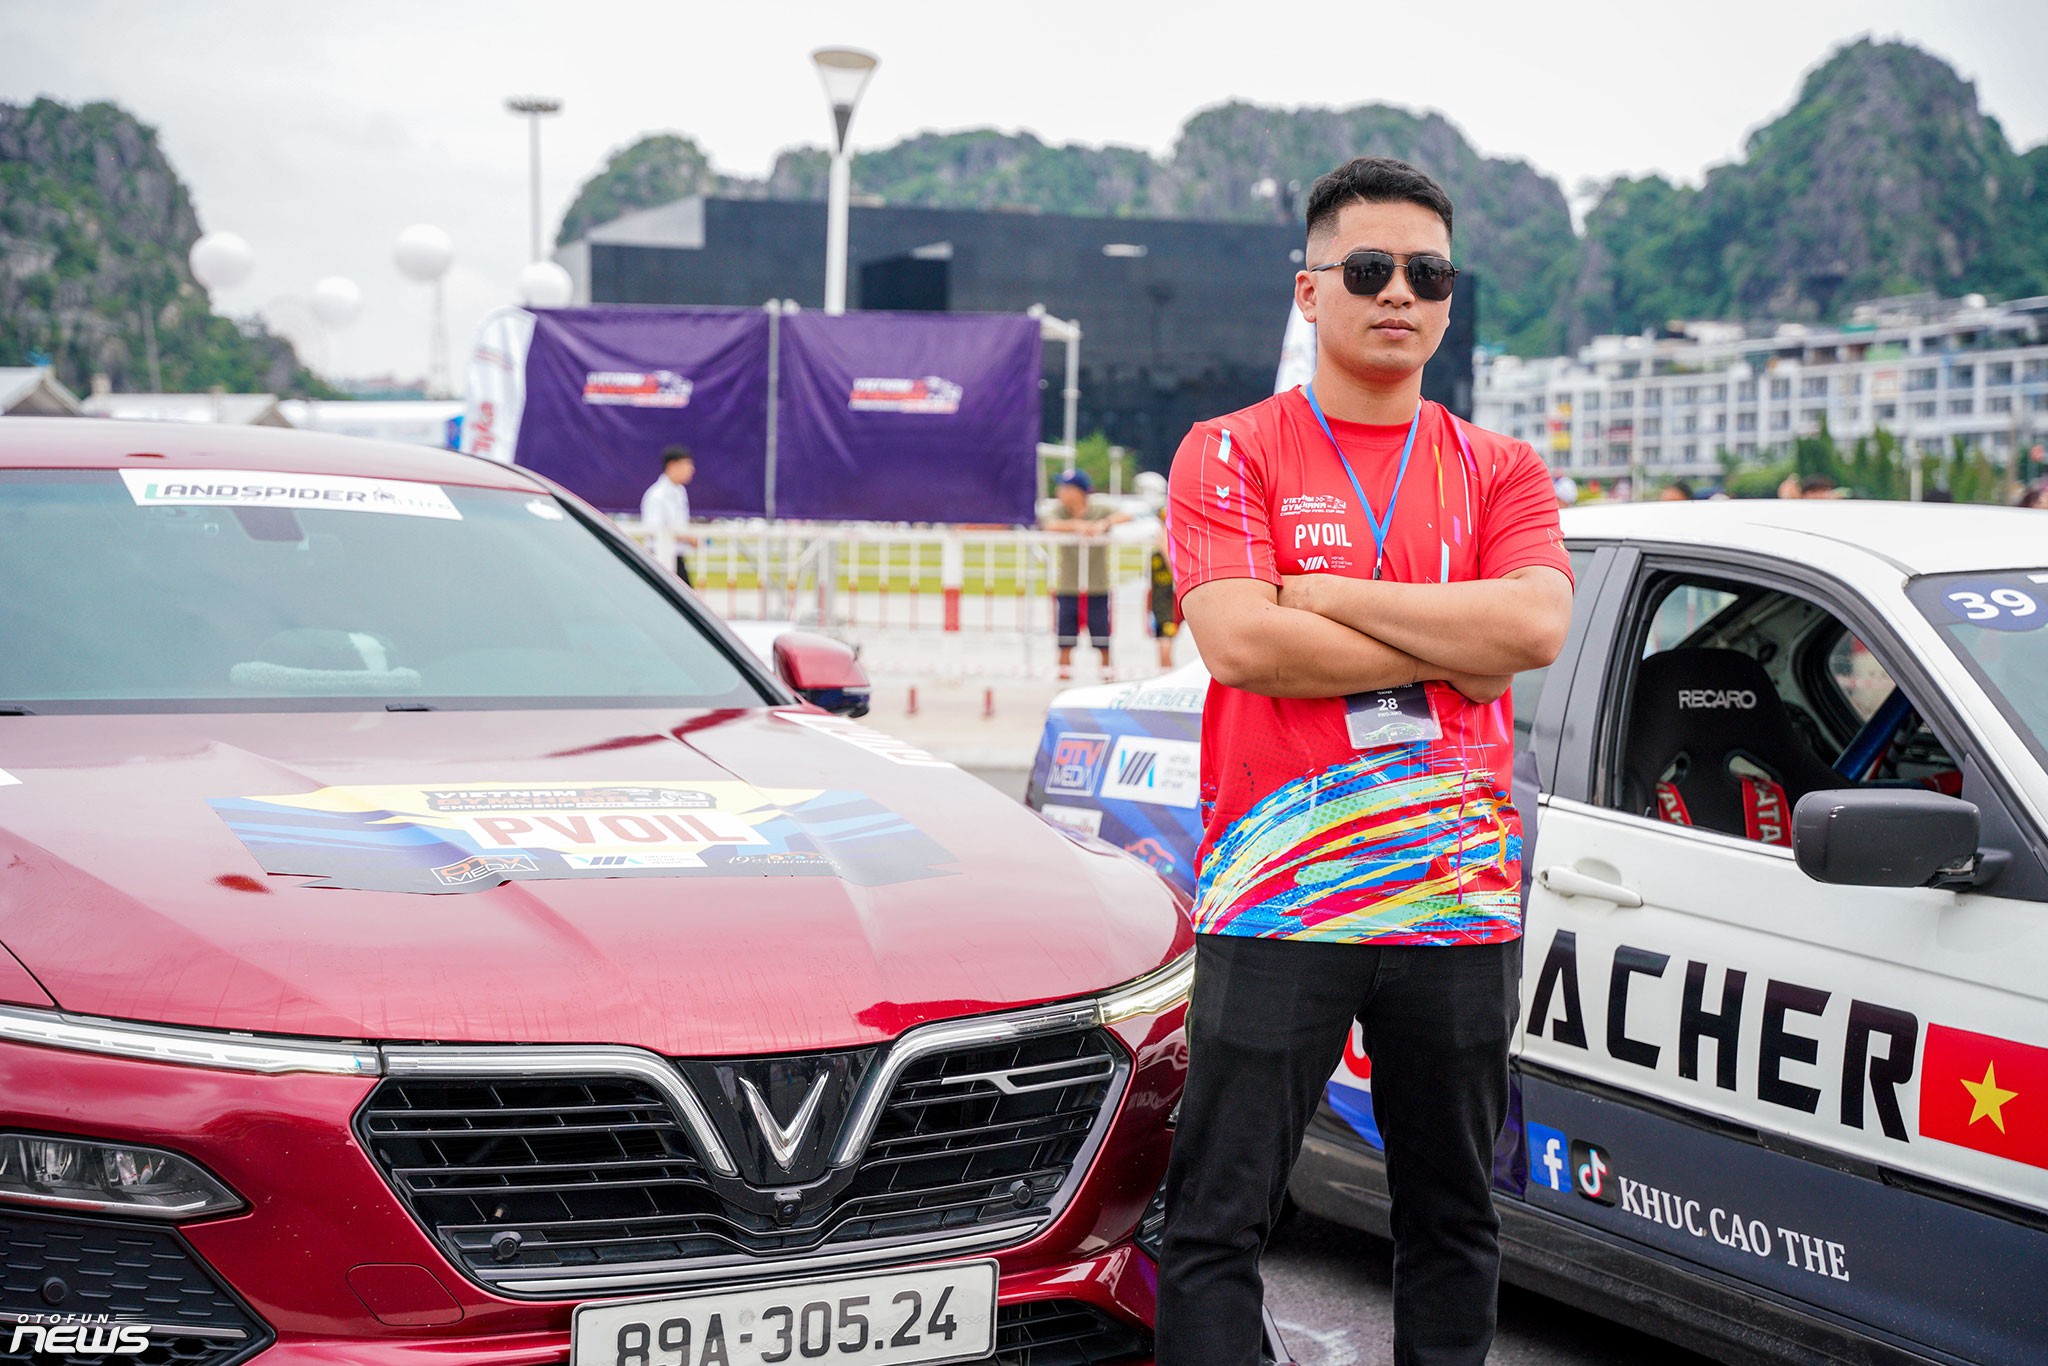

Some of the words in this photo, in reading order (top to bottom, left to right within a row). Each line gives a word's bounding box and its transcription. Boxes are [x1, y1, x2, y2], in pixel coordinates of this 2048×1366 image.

[144, 483, 367, 503] LANDSPIDER
[1294, 522, 1353, 549] PVOIL
[1947, 588, 2038, 620] 39
[1377, 697, 1399, 711] 28
[1677, 689, 1758, 710] RECARO
[433, 790, 577, 799] VIETNAM
[472, 813, 749, 846] PVOIL
[445, 862, 532, 883] MEDIA
[1617, 1175, 1704, 1238] KHUC
[1708, 1207, 1772, 1258] CAO
[1777, 1226, 1850, 1282] THE
[615, 1284, 959, 1366] 89A-305.24
